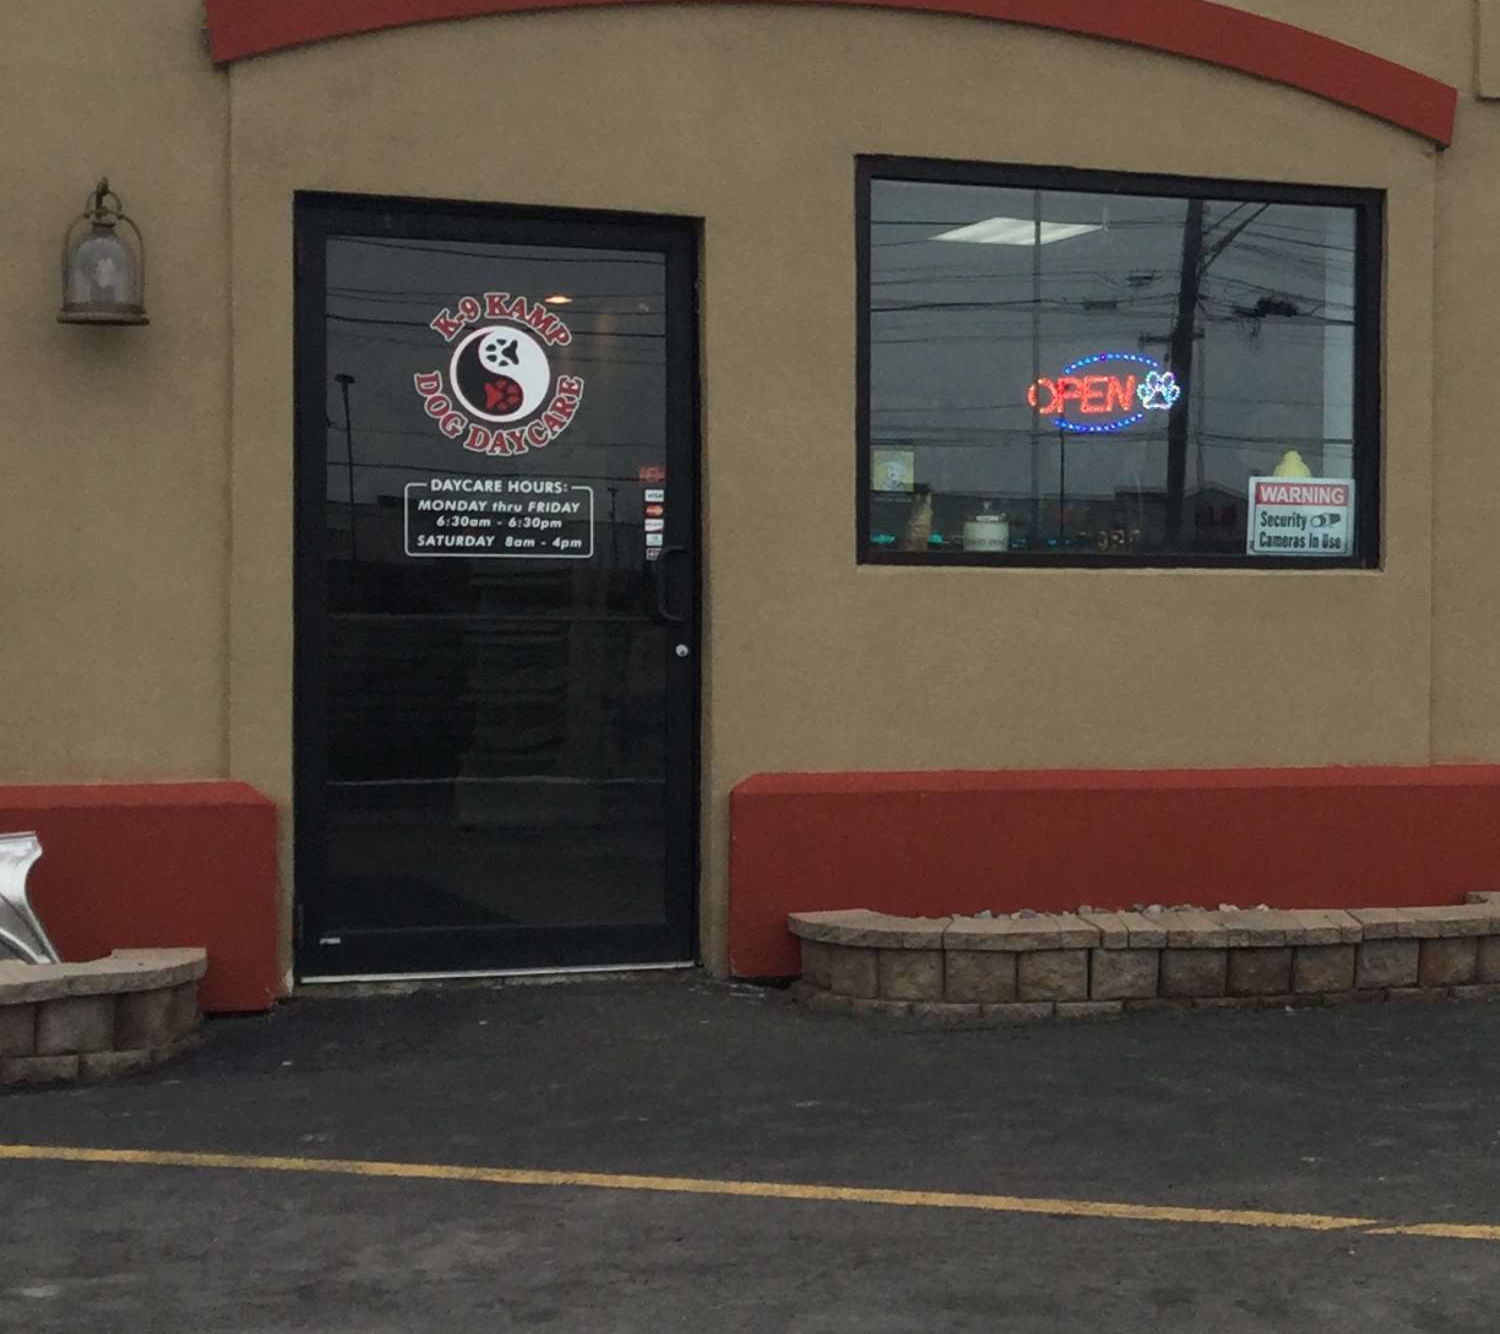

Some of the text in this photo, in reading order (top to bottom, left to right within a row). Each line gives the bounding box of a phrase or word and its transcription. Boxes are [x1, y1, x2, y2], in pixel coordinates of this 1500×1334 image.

[430, 292, 572, 346] K-9 KAMP
[1027, 375, 1136, 414] OPEN
[414, 370, 584, 456] DOG DAYCARE
[430, 478, 569, 494] DAYCARE HOURS:
[1260, 485, 1345, 505] WARNING
[417, 499, 581, 514] MONDAY thru FRIDAY
[436, 516, 492, 528] 6:30am
[507, 517, 563, 531] 6:30pm
[1260, 510, 1308, 531] Security
[416, 534, 496, 548] SATURDAY
[504, 536, 536, 548] 8am
[551, 537, 583, 551] 4pm
[1258, 531, 1342, 550] Cameras In Use
